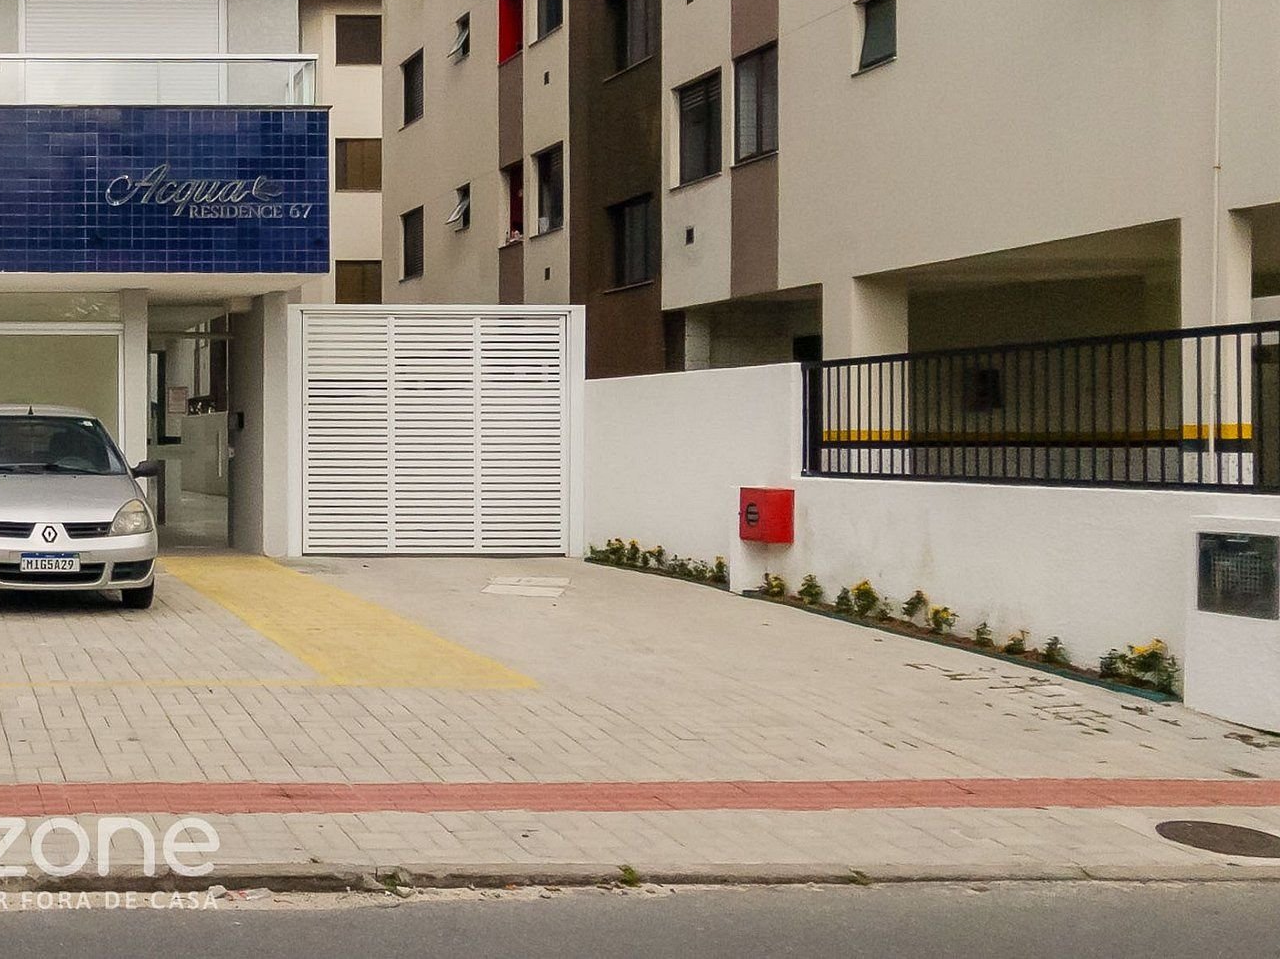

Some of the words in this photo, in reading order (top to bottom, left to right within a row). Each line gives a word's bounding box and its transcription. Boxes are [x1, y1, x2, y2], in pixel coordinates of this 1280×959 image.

[105, 161, 252, 217] Acqua
[188, 205, 283, 219] RESIDENCE
[289, 203, 313, 219] 67
[26, 559, 74, 570] MIG5A29
